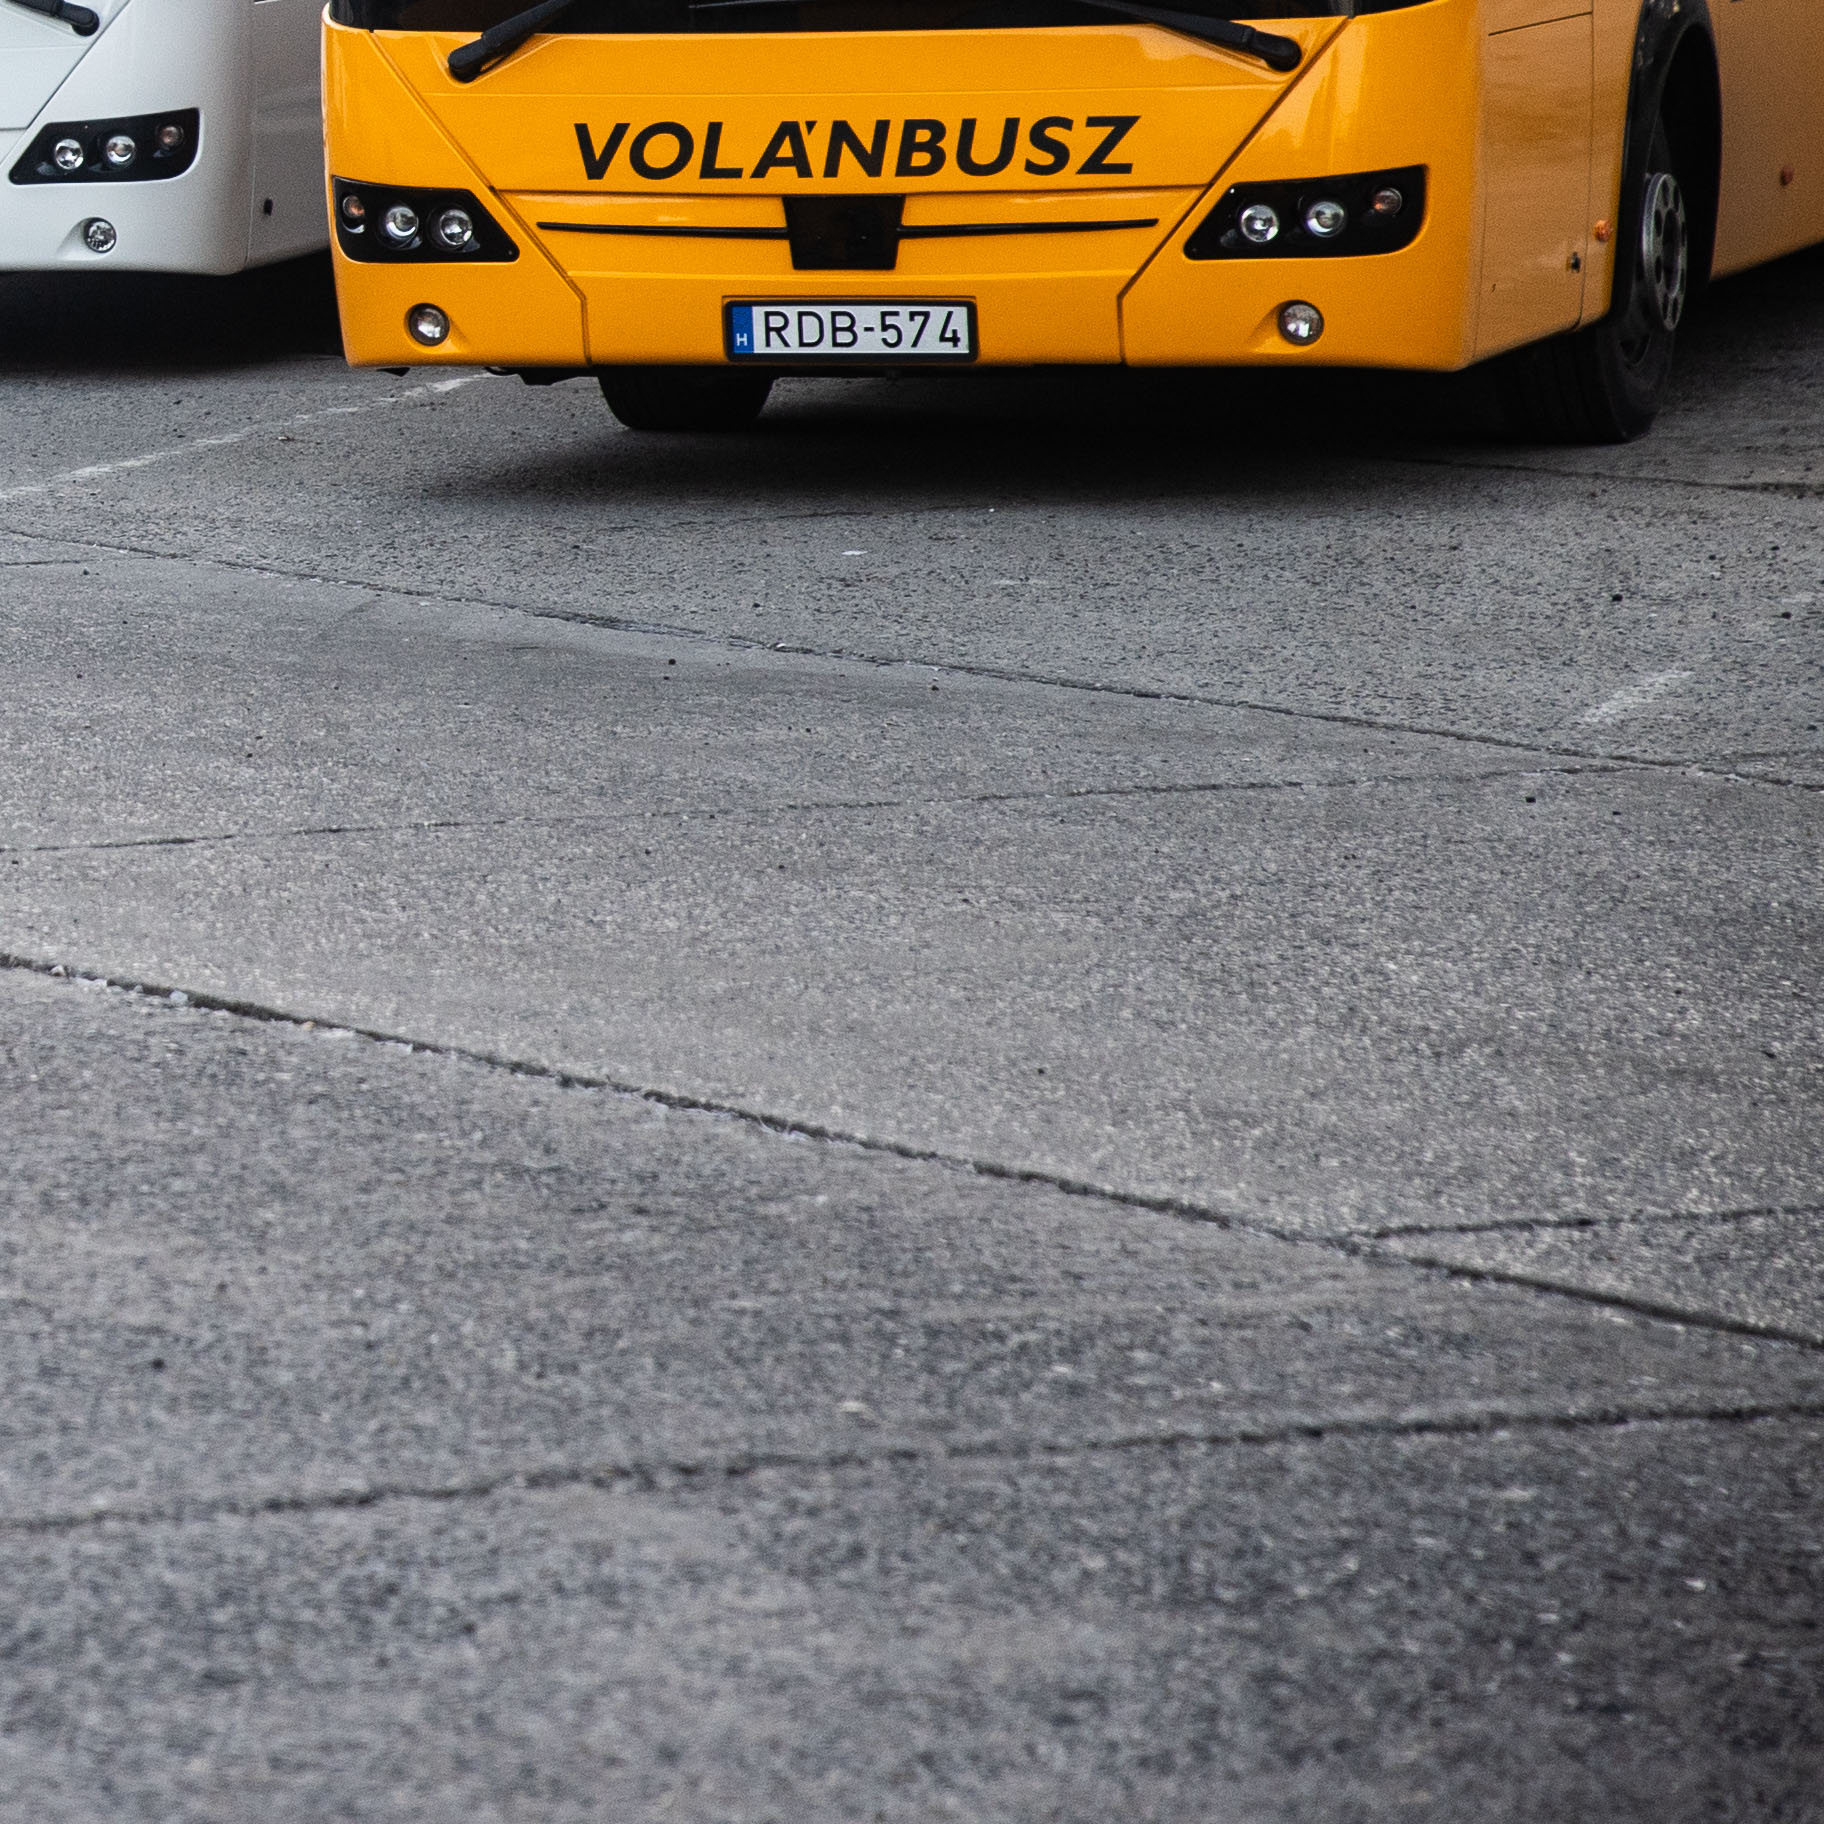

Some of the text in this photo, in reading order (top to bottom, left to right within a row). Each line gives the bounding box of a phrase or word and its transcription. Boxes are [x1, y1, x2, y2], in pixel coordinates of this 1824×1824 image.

[573, 115, 1142, 180] VOLÁNBUSZ
[736, 310, 961, 349] H RDB-574
